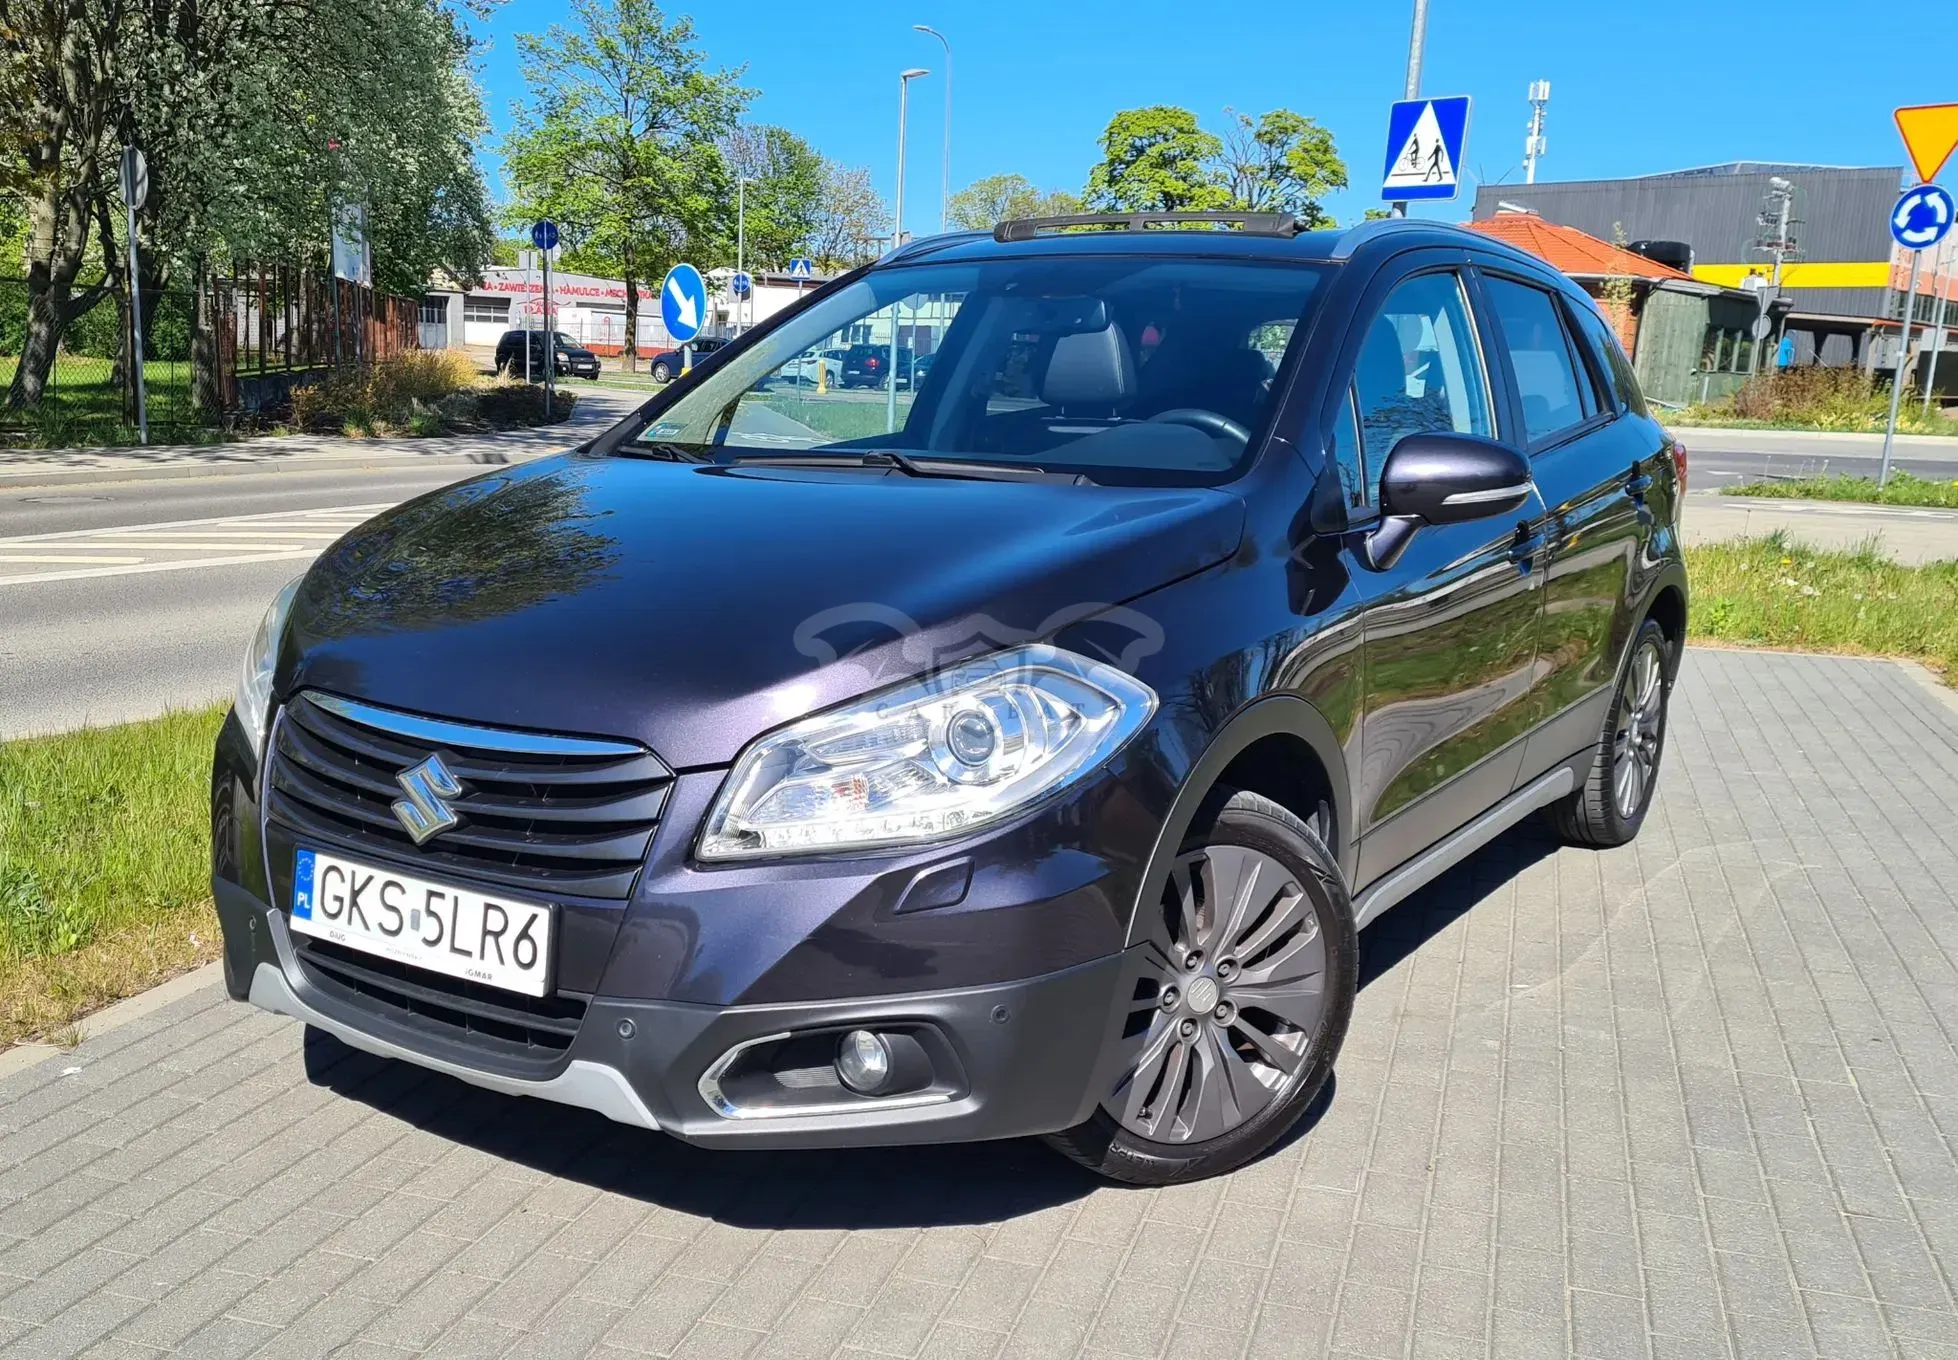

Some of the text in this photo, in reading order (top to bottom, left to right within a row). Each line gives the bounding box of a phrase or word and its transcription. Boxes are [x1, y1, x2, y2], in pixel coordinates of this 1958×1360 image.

[560, 286, 601, 297] HAMULCE
[297, 893, 311, 910] PL
[320, 864, 539, 970] GKS 5LR6
